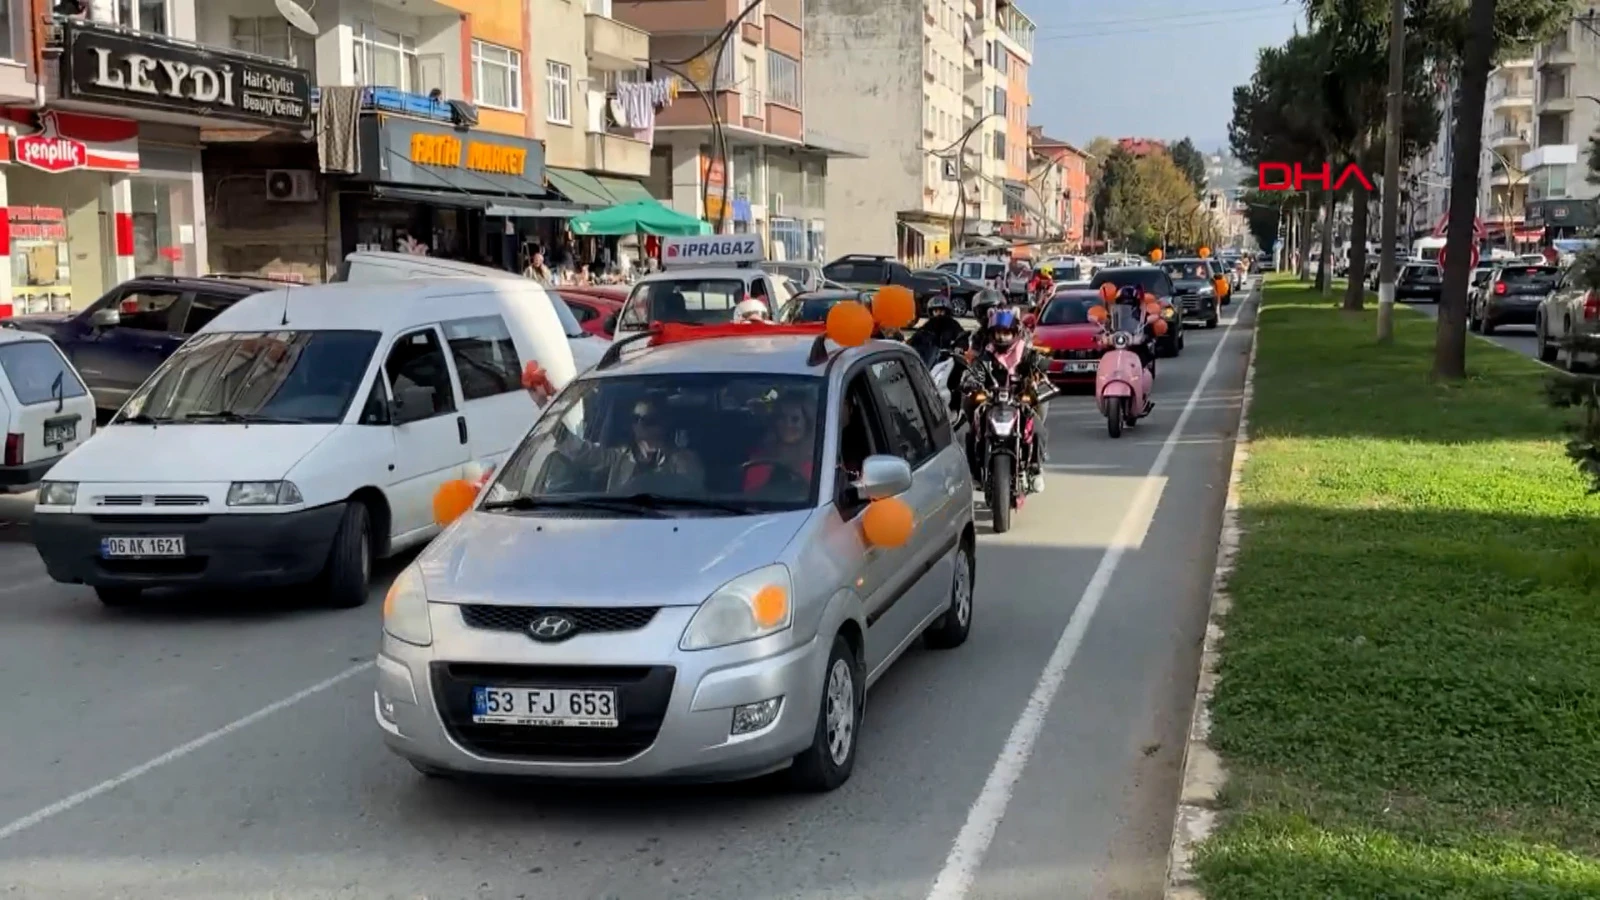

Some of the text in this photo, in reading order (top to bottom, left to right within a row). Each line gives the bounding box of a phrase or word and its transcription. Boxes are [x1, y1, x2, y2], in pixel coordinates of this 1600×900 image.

[94, 47, 235, 106] LEYDİ
[243, 70, 295, 94] Hair Stylist
[243, 94, 304, 117] Beauty Center
[24, 140, 79, 166] şenpiliç
[467, 140, 528, 175] MARKET
[109, 539, 182, 553] 06 AK 1621
[487, 691, 514, 712] 53
[528, 692, 555, 714] FJ
[569, 693, 612, 715] 653
